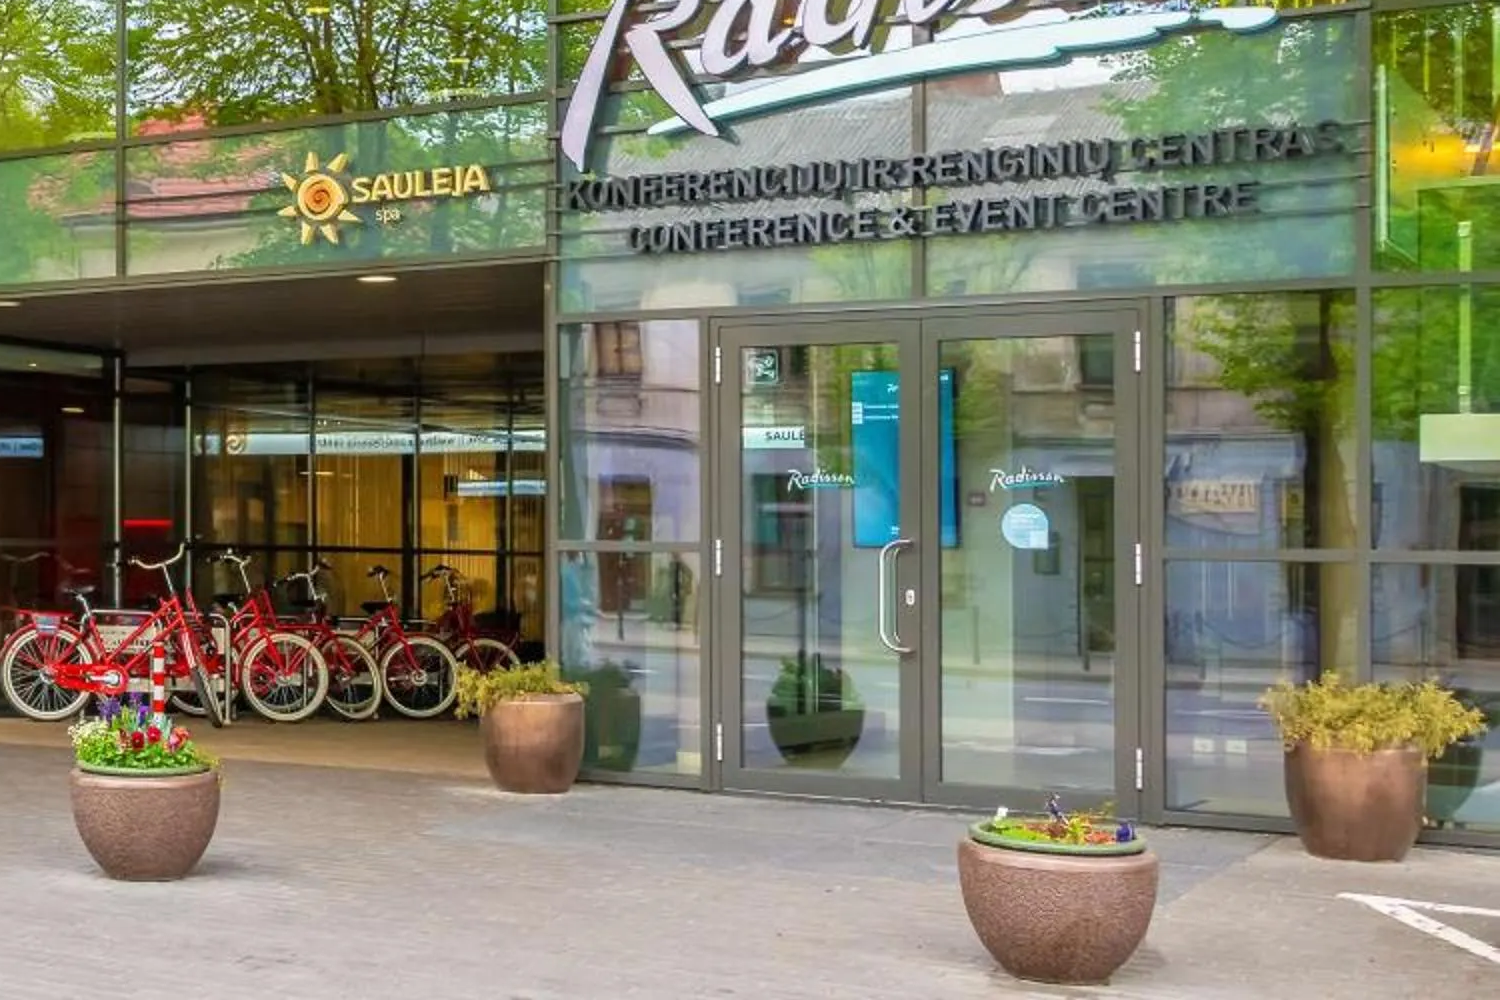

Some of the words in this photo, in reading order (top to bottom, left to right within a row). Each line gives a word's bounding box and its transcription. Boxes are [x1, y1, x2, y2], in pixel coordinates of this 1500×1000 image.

[855, 156, 900, 191] IR
[1122, 120, 1345, 171] CENTRAS
[351, 164, 491, 203] SAULEJA
[375, 207, 401, 224] spa
[628, 210, 877, 254] CONFERENCE
[887, 206, 916, 236] &
[930, 194, 1066, 235] EVENT
[1077, 180, 1260, 222] CENTRE
[787, 467, 856, 493] Radisson
[989, 465, 1065, 493] Radisson
